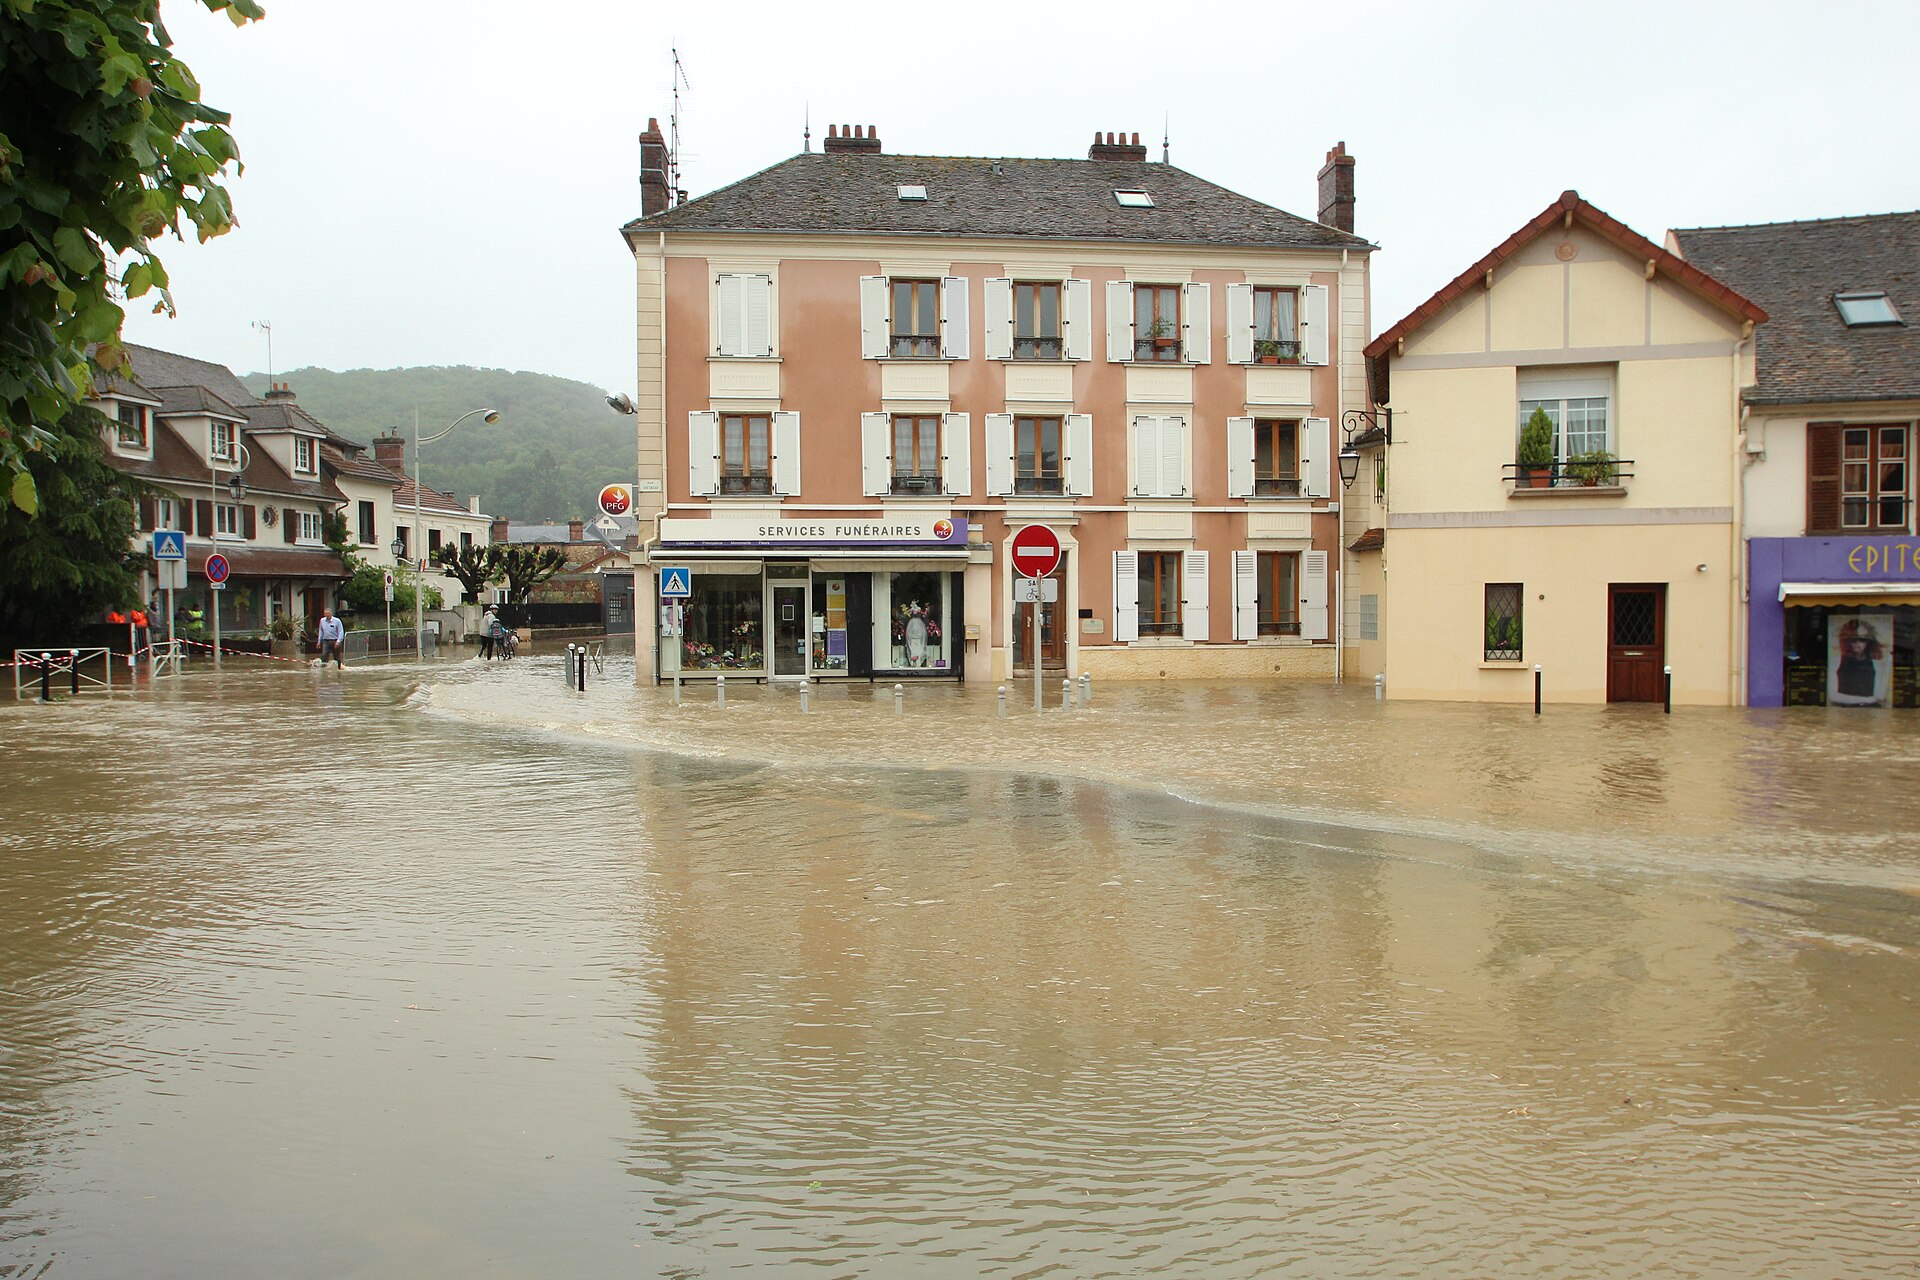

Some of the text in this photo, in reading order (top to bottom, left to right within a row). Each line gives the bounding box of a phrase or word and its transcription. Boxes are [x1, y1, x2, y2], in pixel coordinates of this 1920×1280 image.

[606, 502, 625, 510] PFG
[758, 524, 921, 536] SERVICES FUNÉRAIRES
